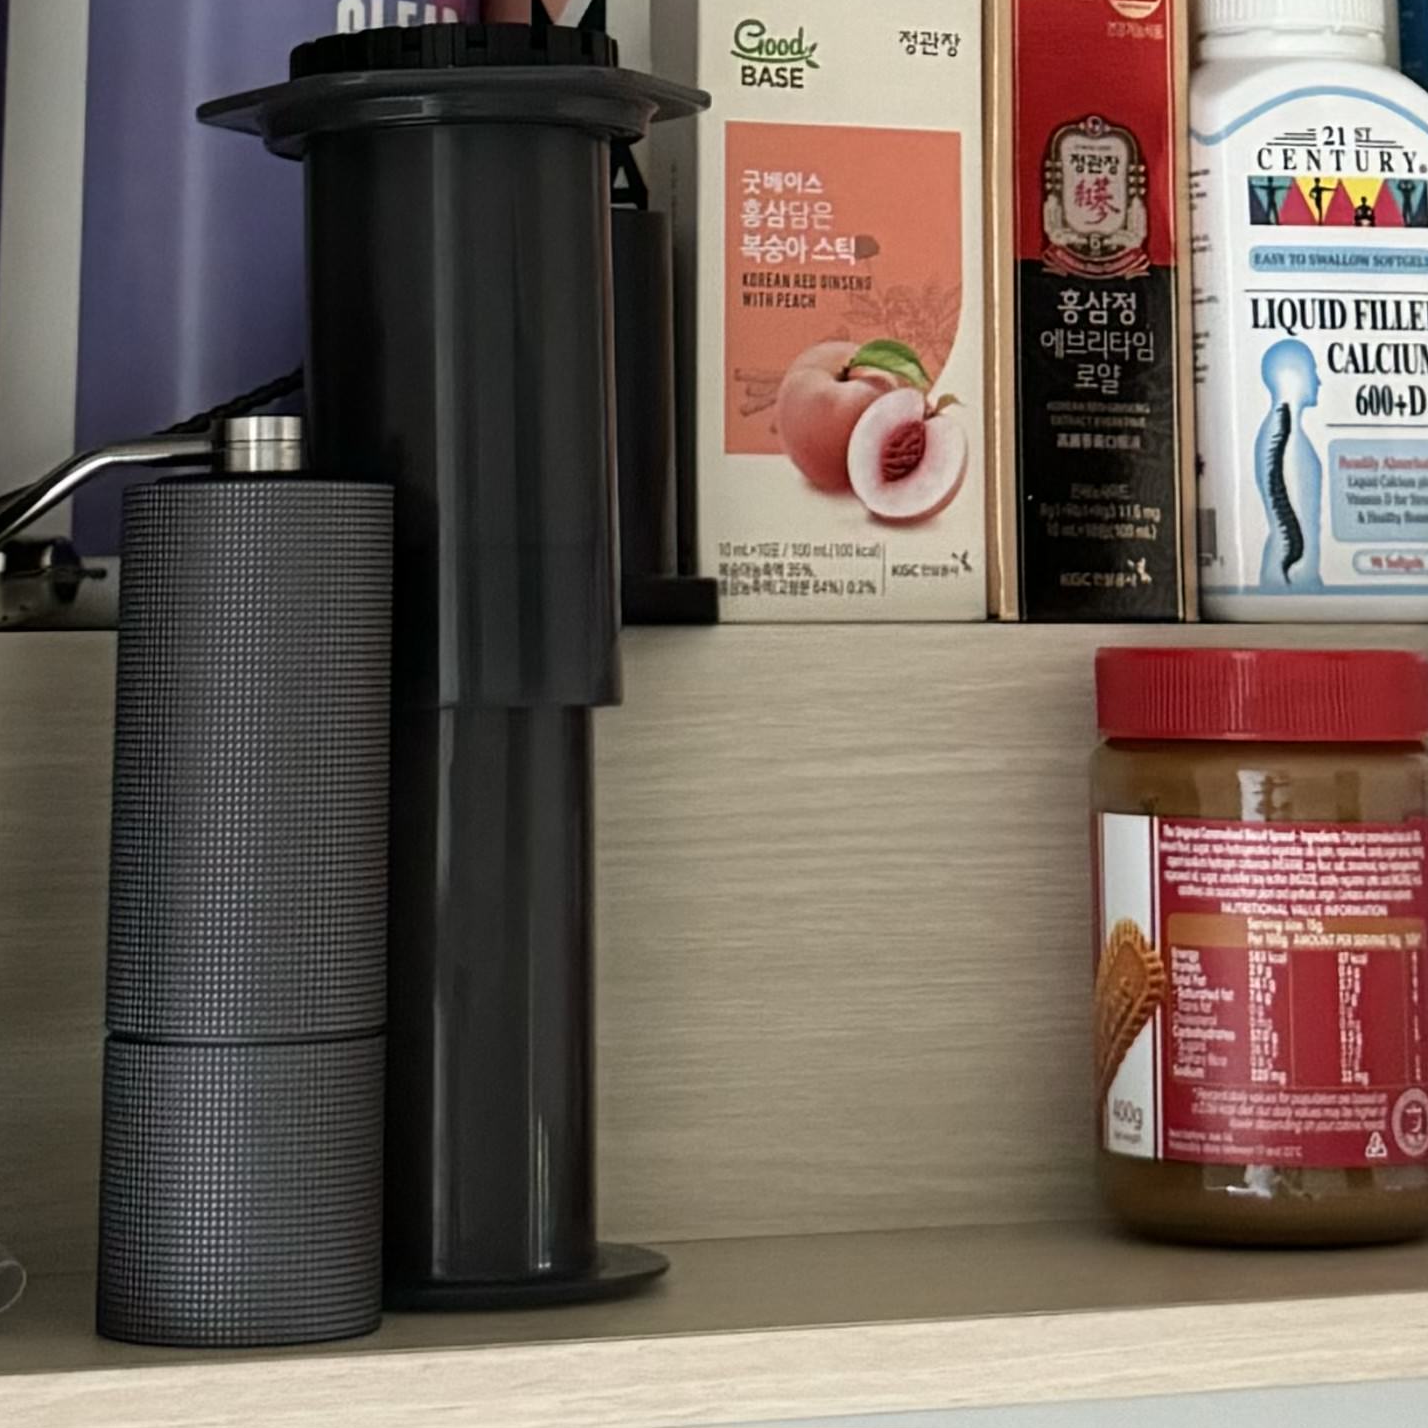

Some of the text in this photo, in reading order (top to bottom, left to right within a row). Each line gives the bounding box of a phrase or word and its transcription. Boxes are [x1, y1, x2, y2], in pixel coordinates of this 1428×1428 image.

[734, 19, 805, 56] Good
[899, 30, 961, 57] 정관장
[741, 66, 804, 88] BASE
[1323, 126, 1372, 146] 21 ST
[1070, 154, 1119, 175] 정관장
[1257, 147, 1417, 173] CENTURY
[741, 170, 823, 195] 굿베이스
[740, 234, 856, 265] 복숭아 스틱
[1254, 253, 1286, 265] EASY
[1290, 253, 1306, 265] TO
[1309, 253, 1370, 267] SWALLOW
[742, 272, 872, 291] KOREAN RED GINSENG
[742, 291, 816, 309] WITH PEACH
[1057, 289, 1137, 325] 홍삼정
[1251, 297, 1347, 336] LIQUID
[1040, 330, 1154, 362] 에브리타임
[1075, 363, 1121, 394] 로얄
[1355, 385, 1427, 417] 600+D
